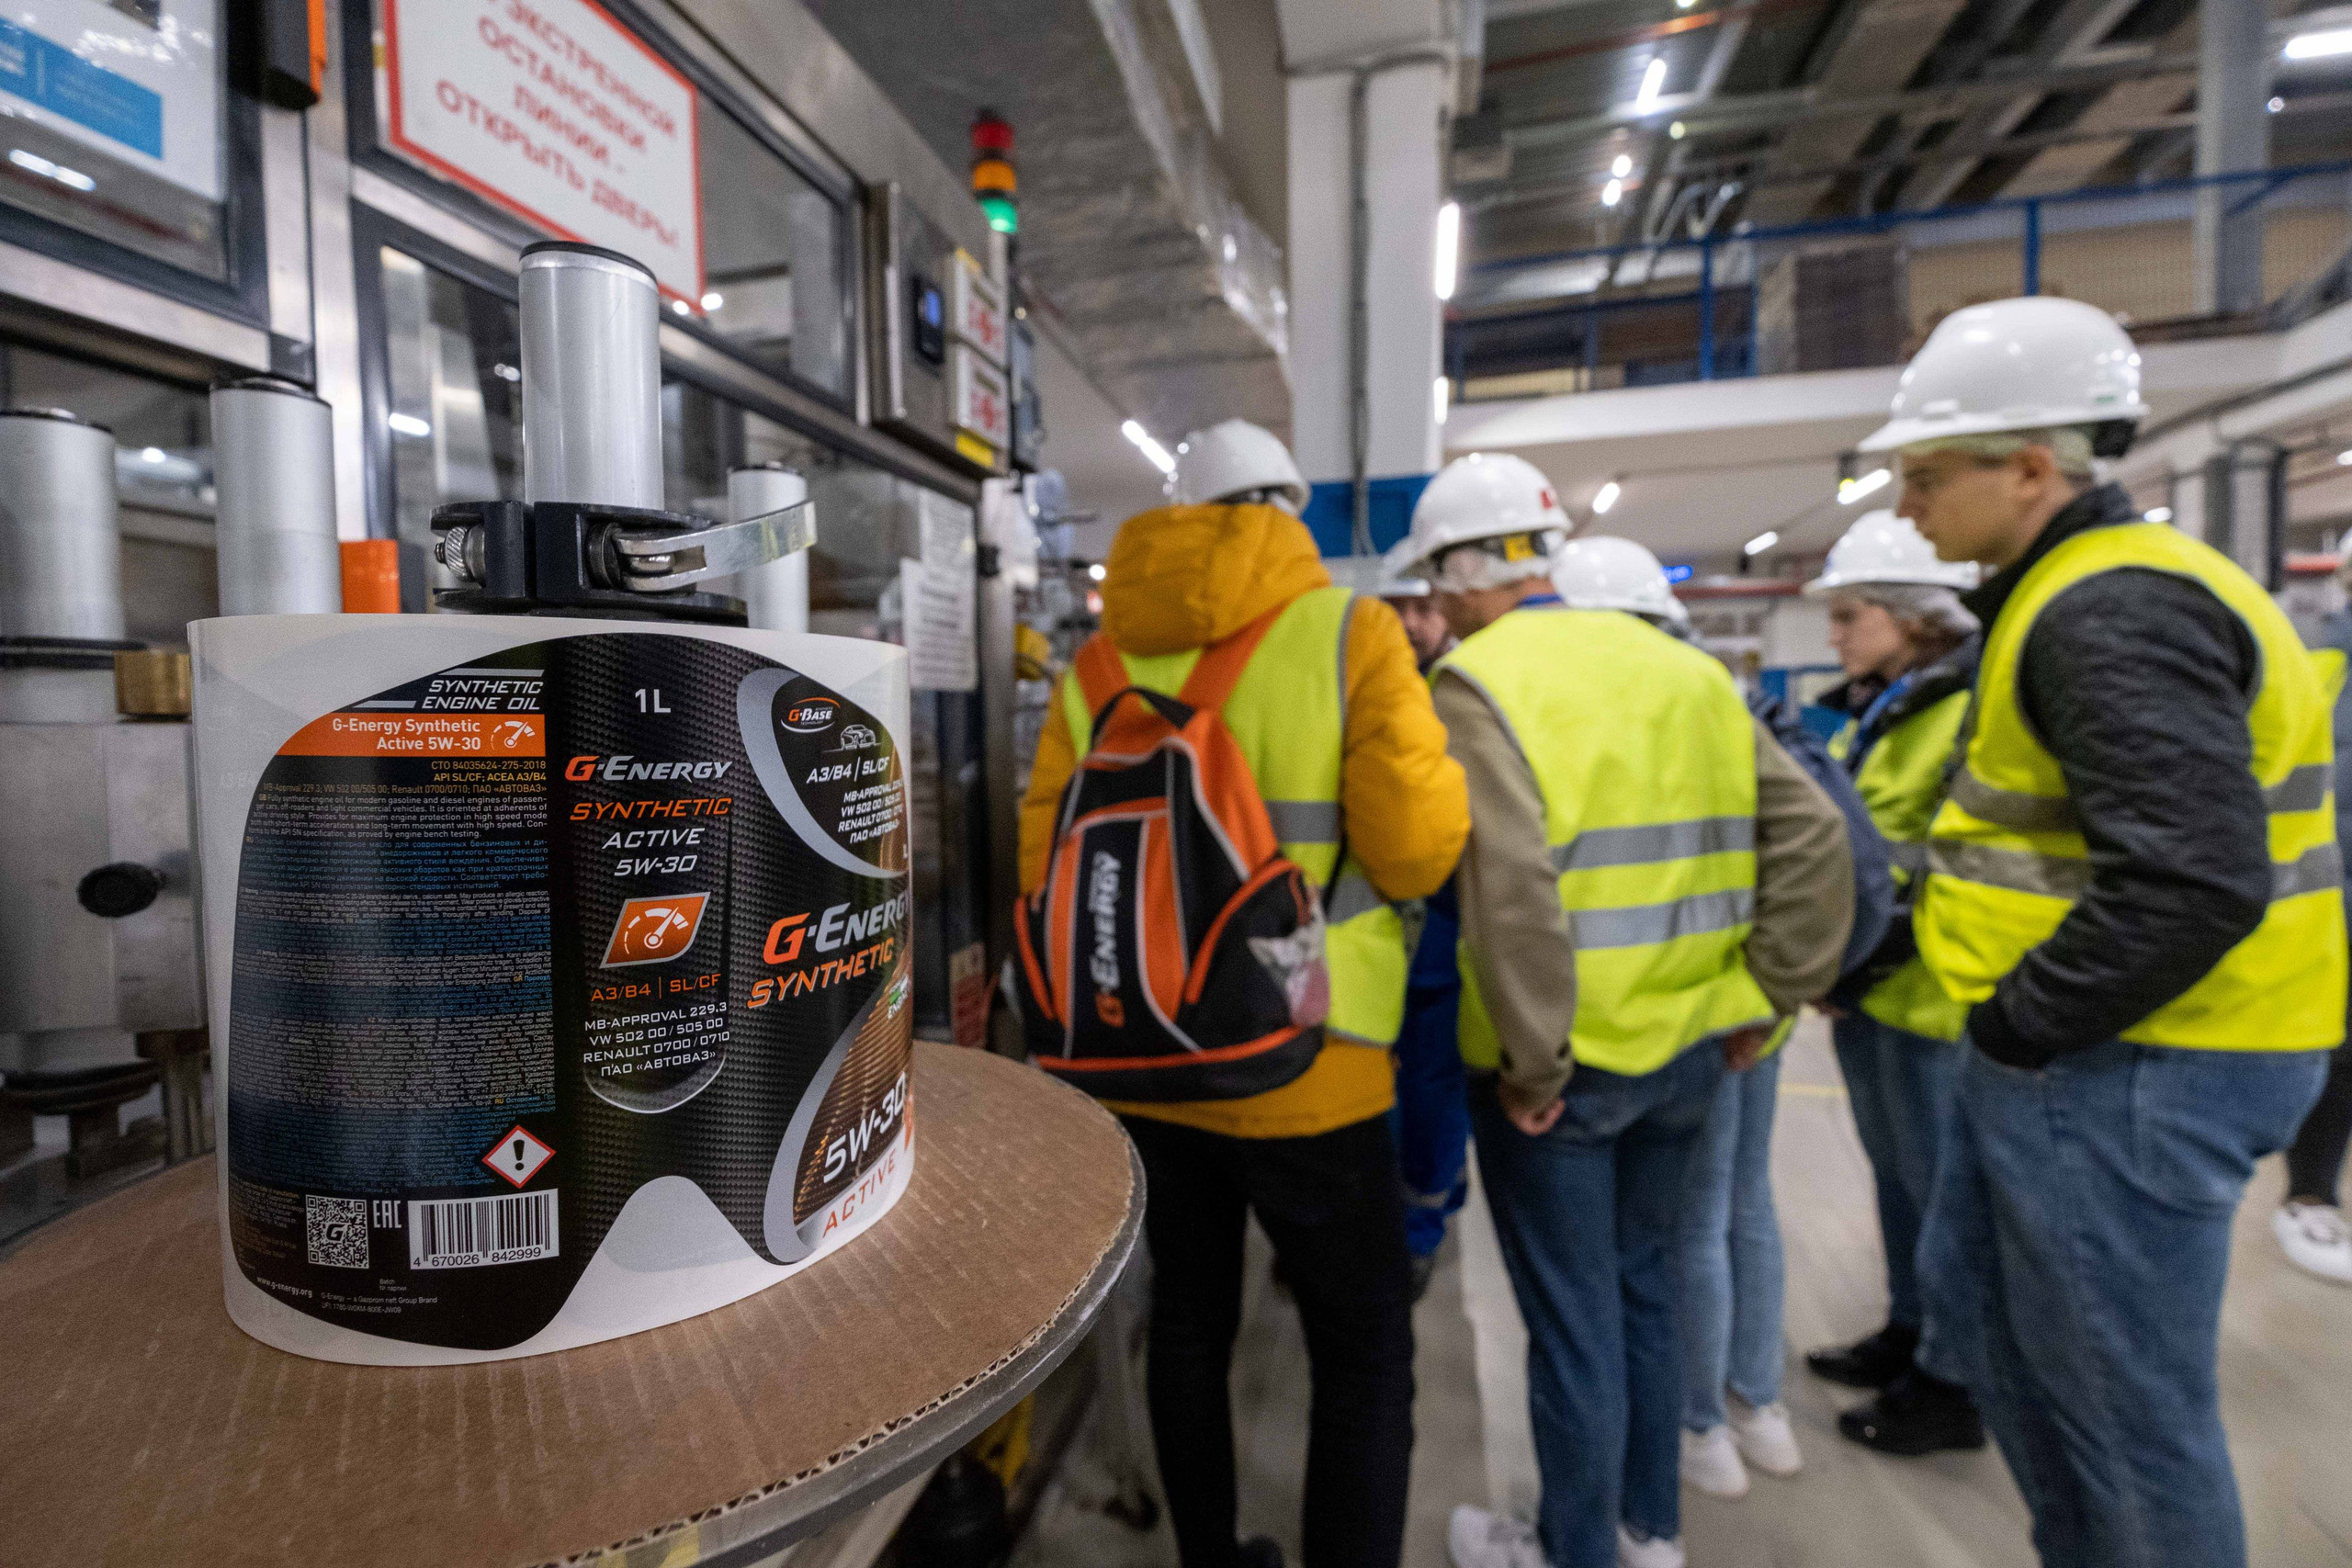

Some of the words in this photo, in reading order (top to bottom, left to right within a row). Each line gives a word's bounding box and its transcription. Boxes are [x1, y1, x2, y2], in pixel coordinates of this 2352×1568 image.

[479, 17, 645, 152] ОСТАНОВКИ
[436, 80, 584, 191] ОТКРЫТЬ
[514, 85, 609, 168] ЛИНИИ
[429, 680, 544, 694] SYNTHETIC
[421, 697, 499, 710] ENGINE
[507, 698, 541, 710] OIL
[635, 688, 672, 714] 1L
[332, 718, 402, 734] G-Energy
[405, 719, 481, 735] Synthetic
[377, 737, 424, 750] Active
[428, 737, 481, 750] 5W-30
[431, 761, 450, 770] СТО
[452, 761, 547, 770] 84035624-275-2018
[806, 764, 852, 784] A3/B4
[861, 756, 890, 776] SL/CF
[434, 773, 450, 782] API
[452, 773, 485, 783] SL/CF;
[487, 773, 514, 781] ACEA
[516, 772, 547, 781] A3/B4
[267, 795, 281, 803] Fully
[282, 795, 310, 804] synthetic
[311, 796, 334, 805] engine
[388, 796, 422, 805] gasoline
[467, 796, 501, 805] engines
[513, 796, 548, 805] passen-
[391, 784, 424, 794] Renault
[424, 784, 470, 795] 0700/0710;
[472, 784, 492, 793] ПАО
[493, 784, 547, 793] «АВТОВАЗ»
[269, 811, 288, 819] driving
[390, 814, 417, 822] engine
[419, 814, 461, 822] protection
[474, 813, 492, 822] high
[495, 813, 521, 821] speed
[330, 805, 346, 813] light
[493, 804, 537, 812] adherents
[569, 797, 733, 821] SYNTHETIC
[841, 805, 855, 818] VW
[855, 802, 872, 815] 502
[357, 830, 383, 839] proved
[384, 830, 394, 840] by
[395, 831, 422, 840] engine
[450, 830, 481, 840] testing.
[371, 822, 411, 830] long-term
[476, 821, 495, 830] high
[497, 821, 525, 829] speed.
[838, 817, 876, 833] RENAULT
[601, 828, 706, 850] ACTIVE
[850, 829, 868, 844] ПАО
[486, 864, 549, 873] краткосрочных
[613, 854, 698, 876] 5W-30
[747, 937, 895, 1009] SYNTHETIC
[591, 983, 651, 1002] A3/B4
[670, 973, 721, 993] SL/CF
[584, 1009, 686, 1031] MB-APPROVAL
[689, 1002, 728, 1017] 229.3
[589, 1033, 612, 1046] VW
[616, 1030, 644, 1043] 502
[647, 1027, 667, 1040] 00
[676, 1021, 704, 1035] 505
[706, 1017, 724, 1029] 00
[583, 1044, 651, 1063] RENAULT
[653, 1038, 692, 1054] 0700
[699, 1031, 730, 1045] 0710
[601, 1064, 633, 1077] ПАО
[636, 1050, 717, 1071] «АВТОВАЗ»
[823, 1070, 906, 1183] 5W-30
[822, 1149, 897, 1238] ACTIVE
[413, 1257, 421, 1268] 4
[431, 1254, 480, 1267] 670026
[492, 1247, 542, 1262] 842999
[256, 1276, 313, 1298] www.g-energy.org
[321, 1292, 345, 1303] G-Energy
[358, 1296, 385, 1304] Gazprom
[398, 1296, 416, 1304] Group
